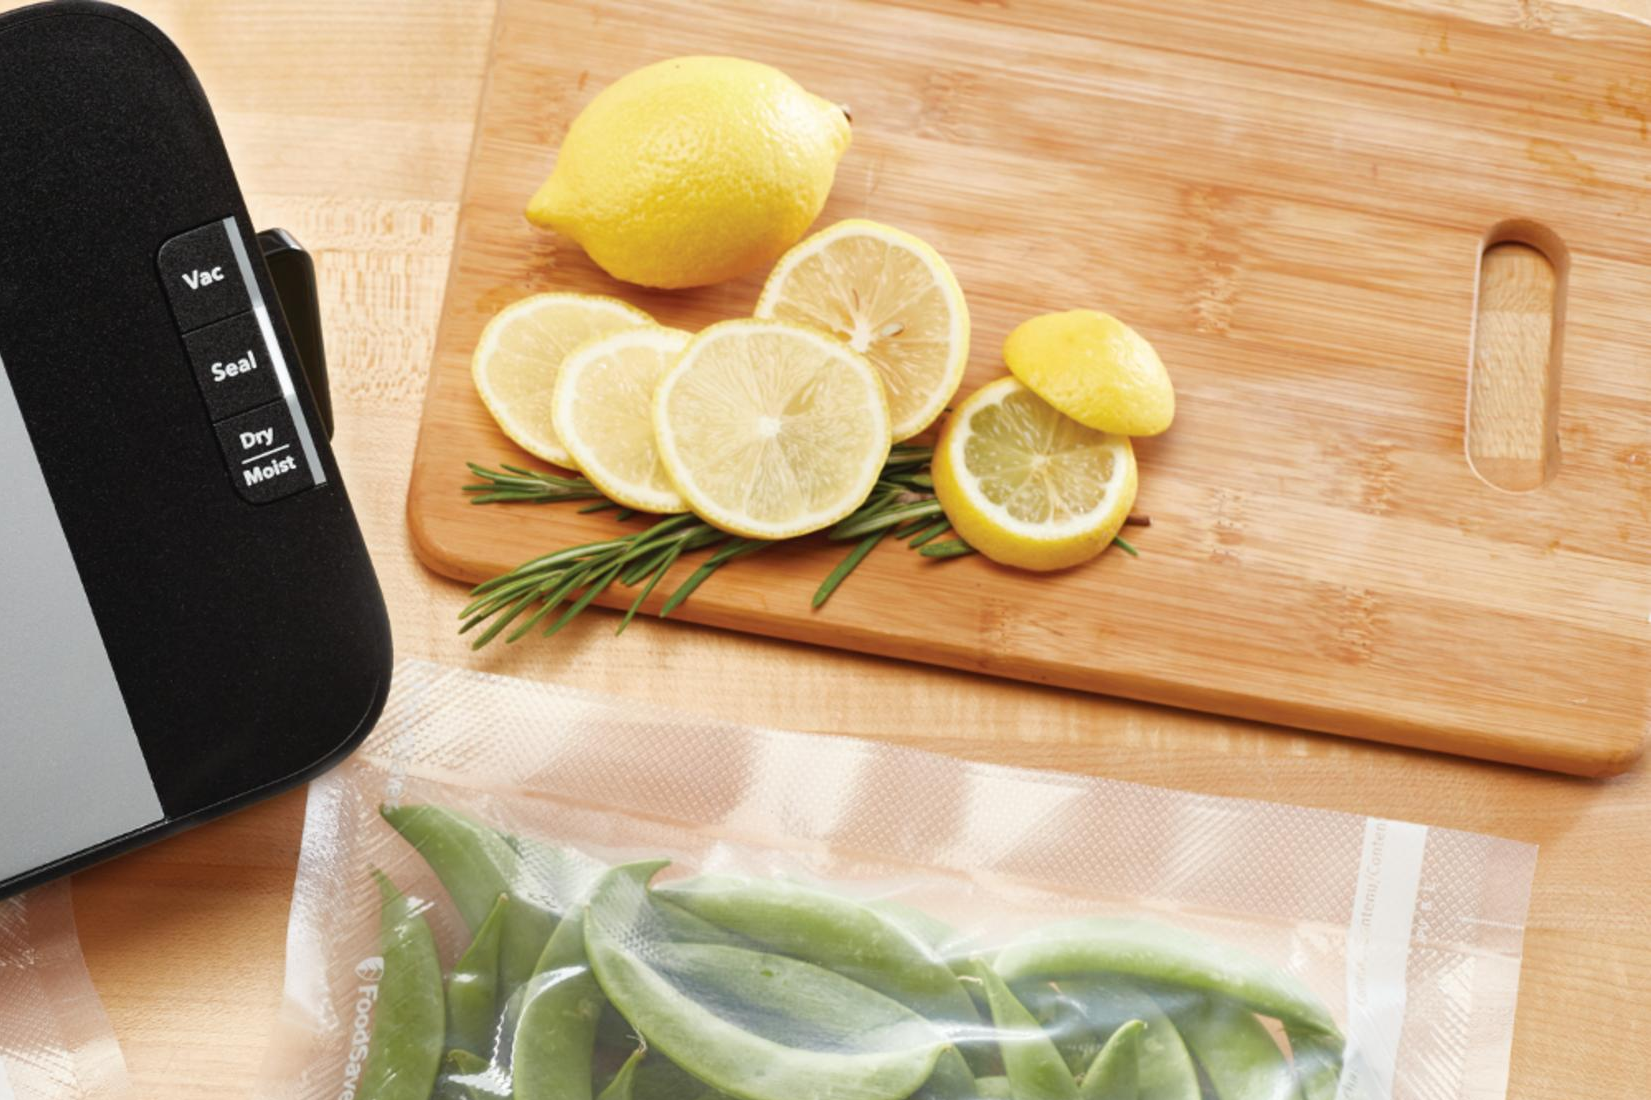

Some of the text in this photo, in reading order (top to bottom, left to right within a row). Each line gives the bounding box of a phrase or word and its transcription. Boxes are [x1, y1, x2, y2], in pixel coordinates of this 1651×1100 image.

[182, 266, 225, 290] Vac
[211, 350, 258, 382] Seal
[239, 427, 274, 450] Dry
[242, 454, 297, 486] Moist
